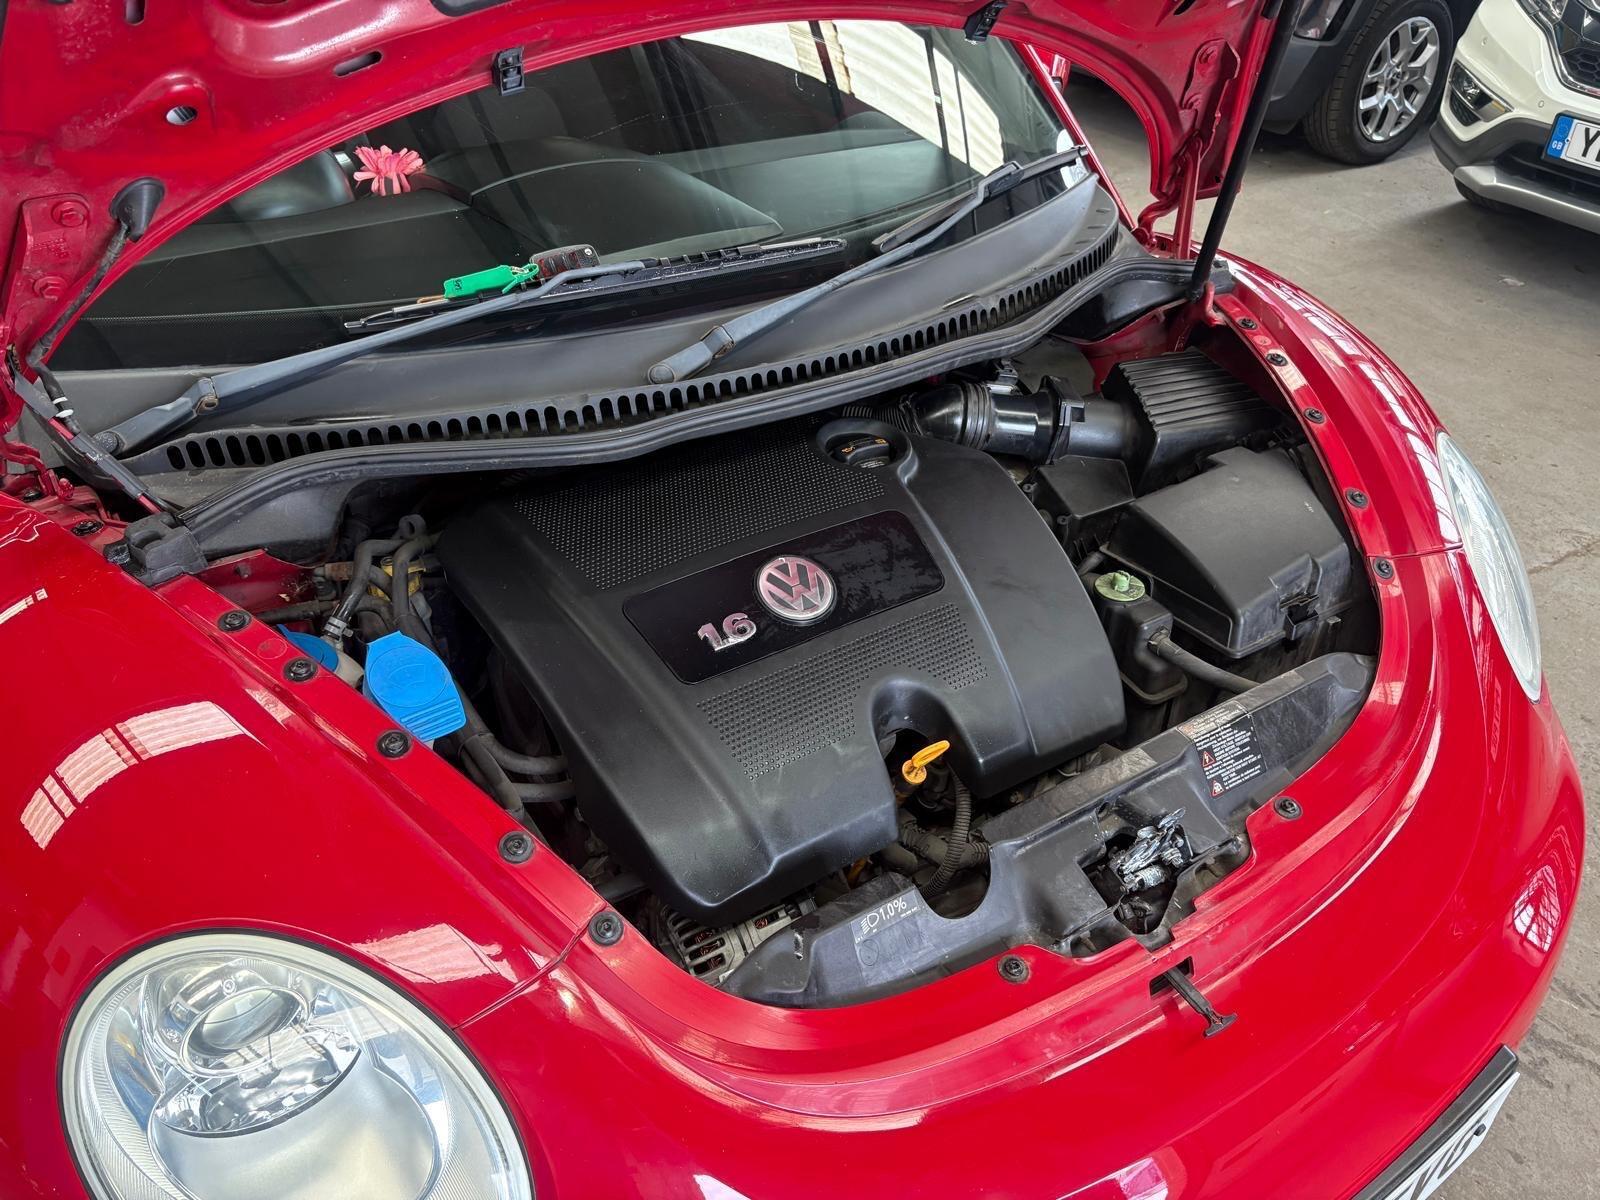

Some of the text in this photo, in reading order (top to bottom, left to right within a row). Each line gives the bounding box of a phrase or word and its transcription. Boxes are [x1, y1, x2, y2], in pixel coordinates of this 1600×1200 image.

[1551, 140, 1563, 150] GB
[1581, 127, 1600, 162] Y
[879, 897, 907, 920] 1,0%
